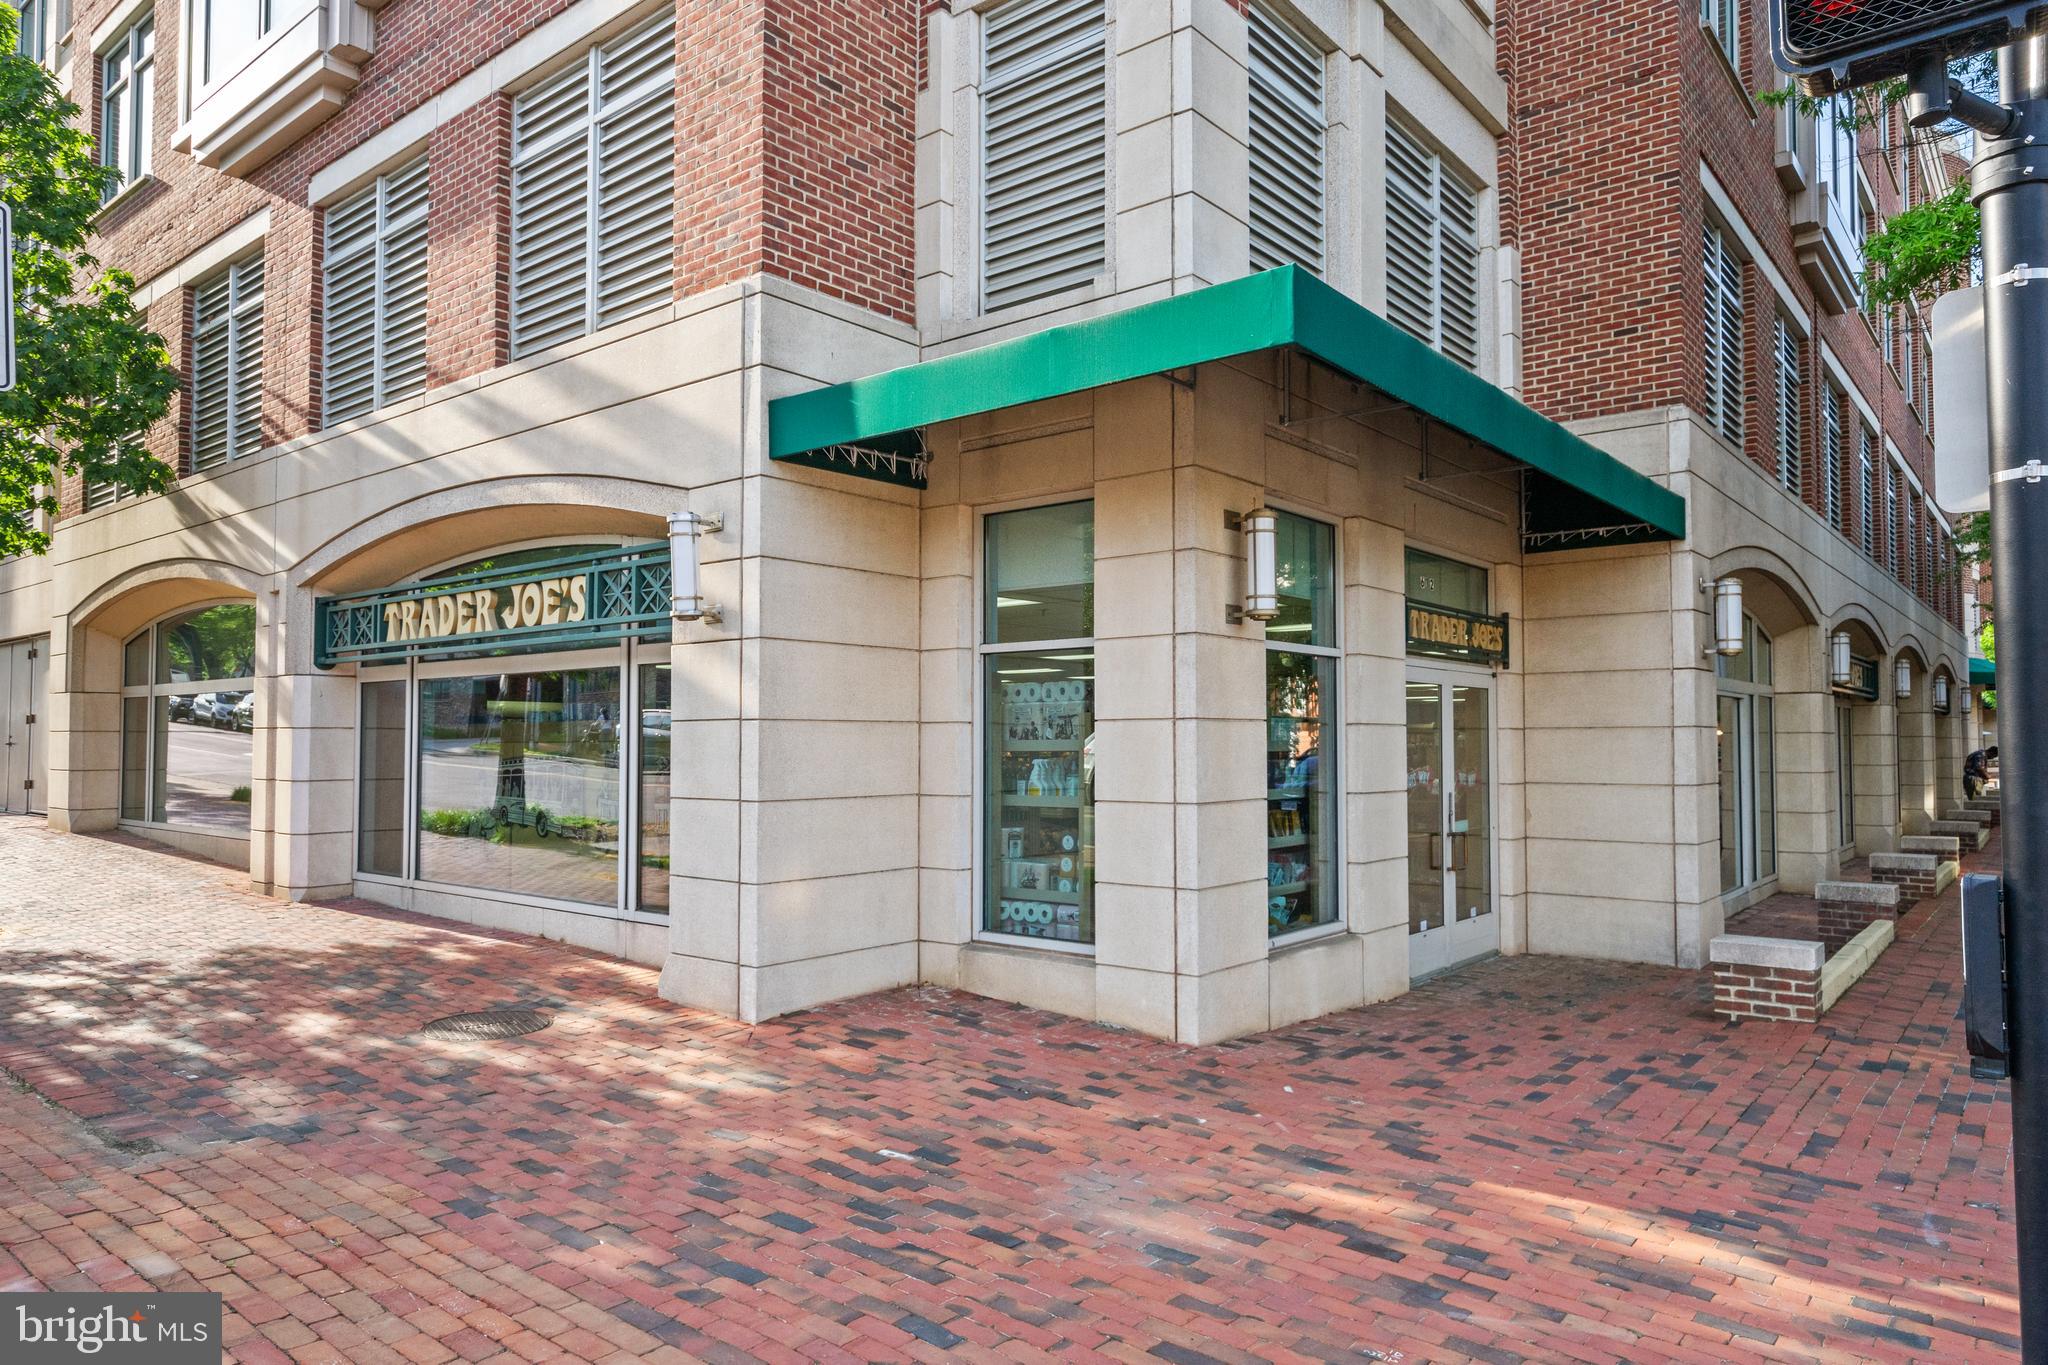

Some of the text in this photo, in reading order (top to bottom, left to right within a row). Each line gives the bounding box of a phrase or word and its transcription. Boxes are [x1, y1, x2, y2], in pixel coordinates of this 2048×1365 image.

[383, 575, 587, 642] TRADER JOE'S
[1410, 609, 1468, 646] TRADER
